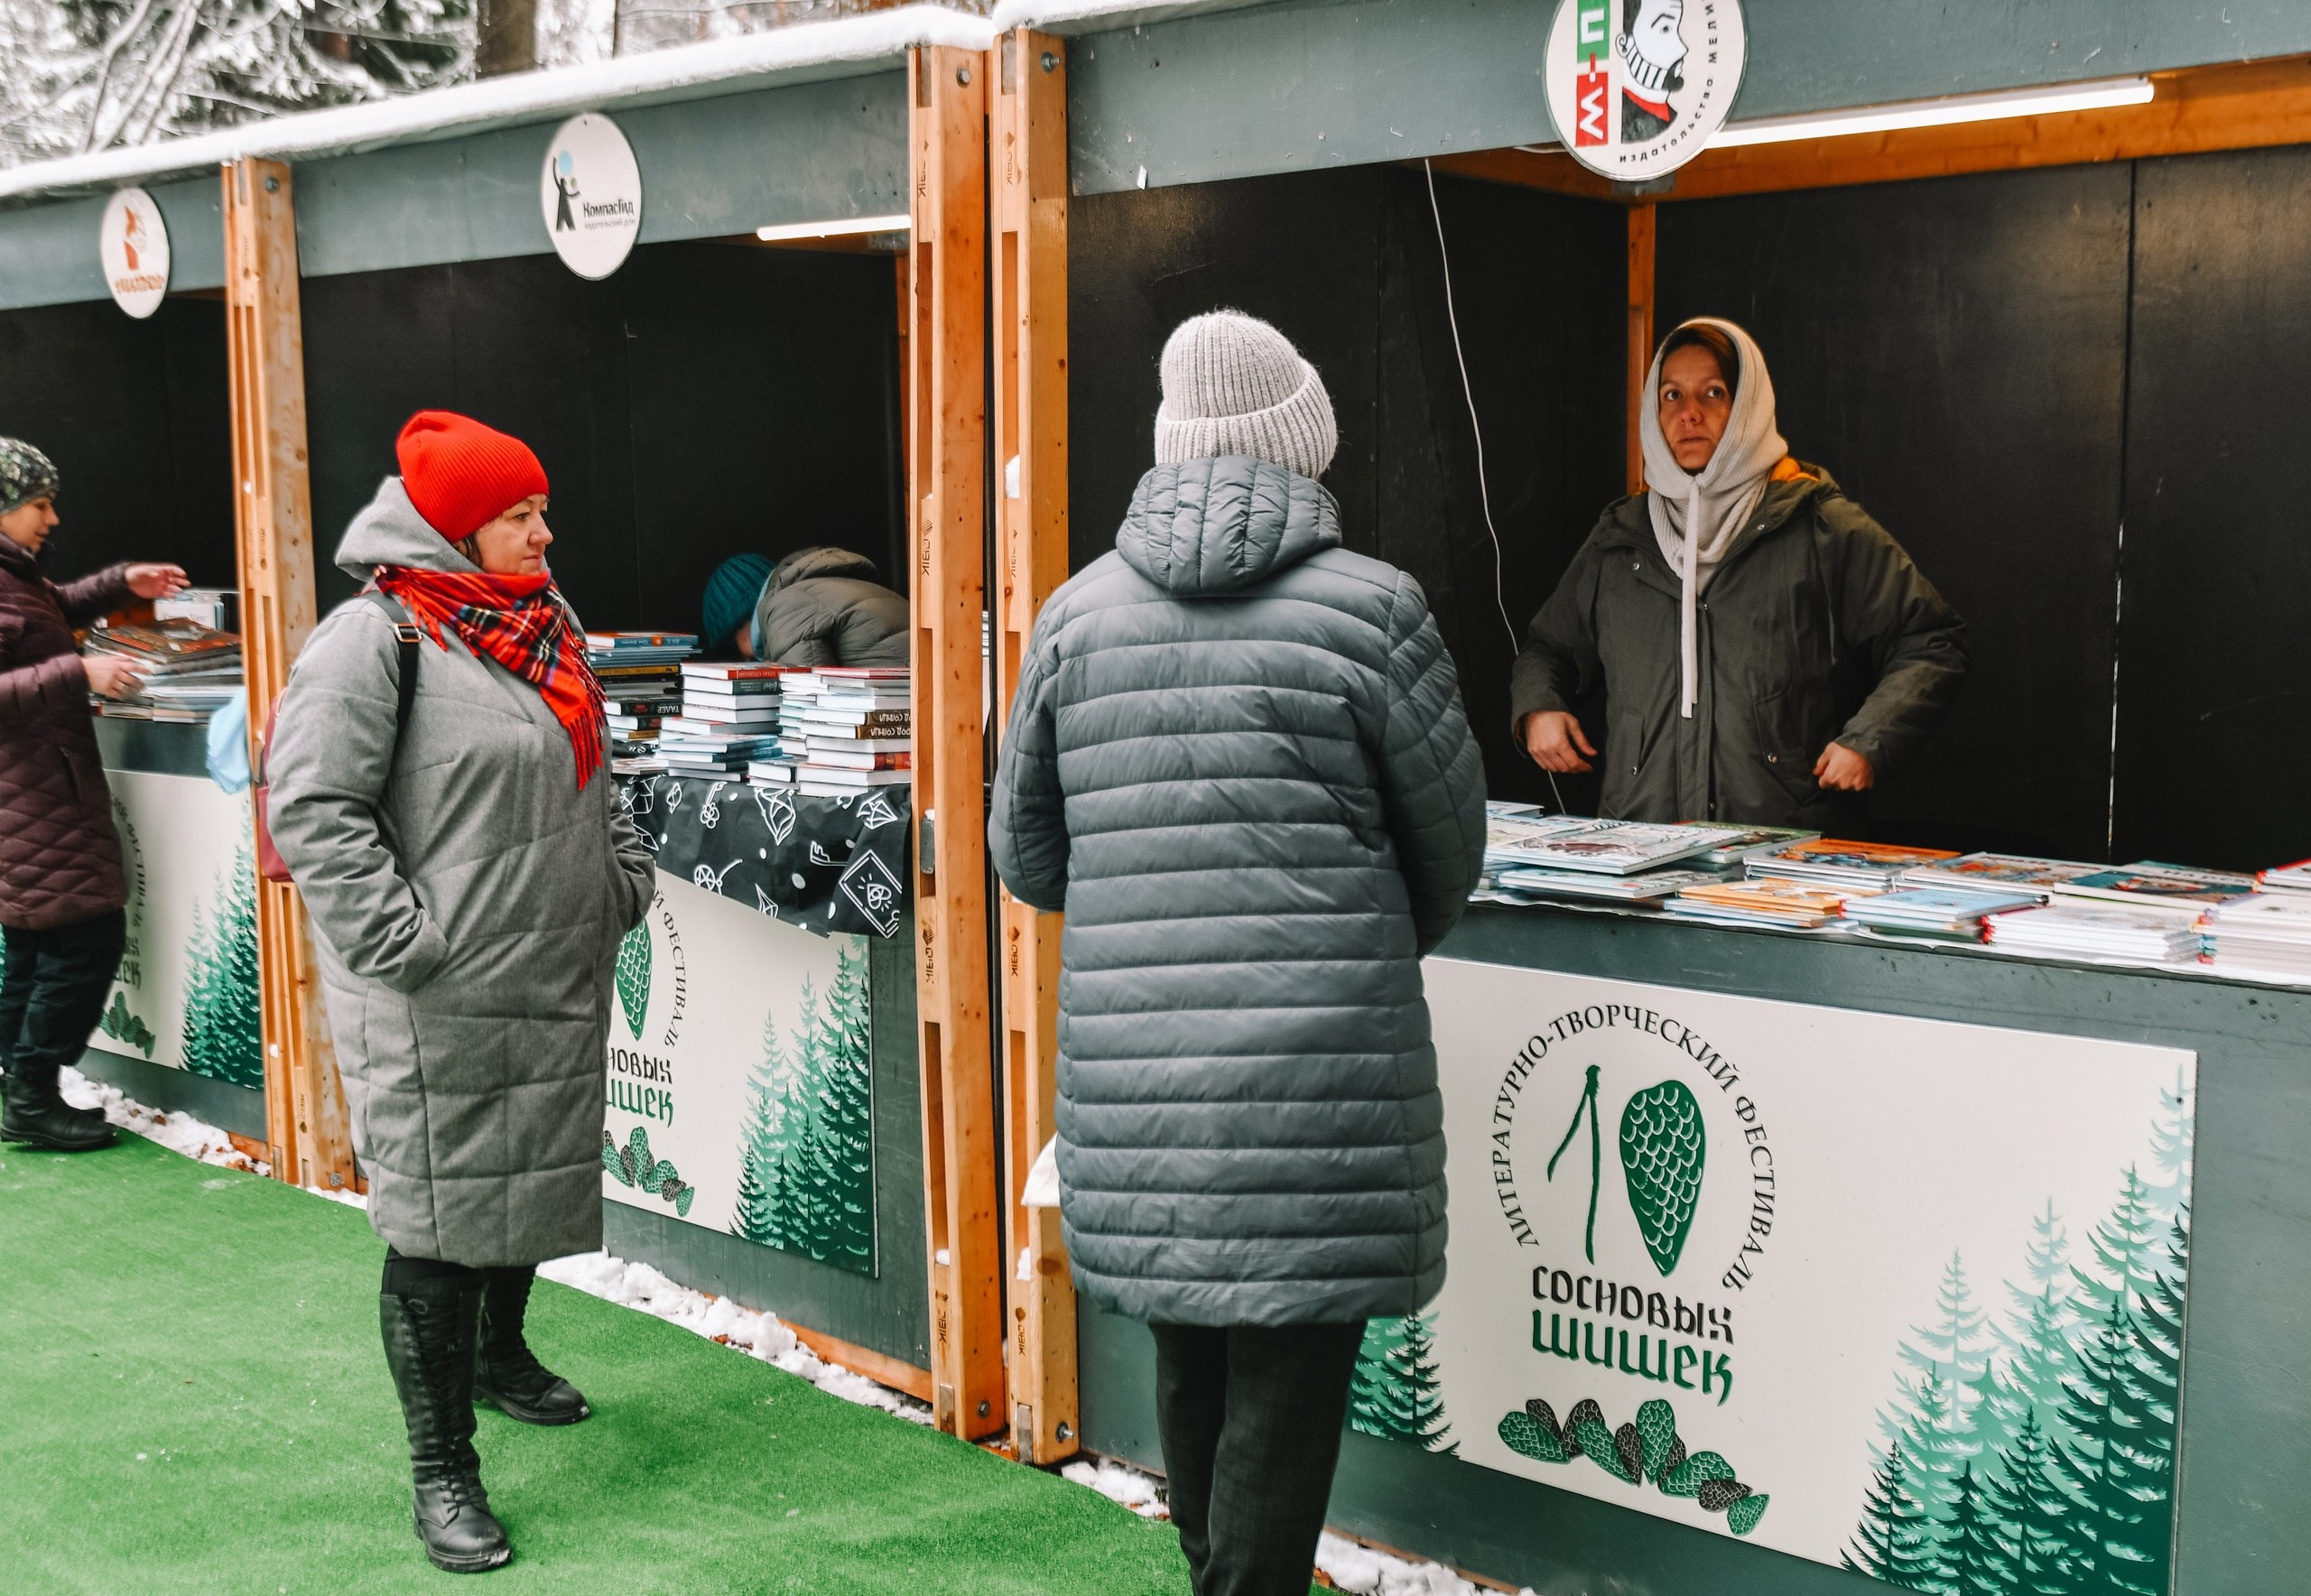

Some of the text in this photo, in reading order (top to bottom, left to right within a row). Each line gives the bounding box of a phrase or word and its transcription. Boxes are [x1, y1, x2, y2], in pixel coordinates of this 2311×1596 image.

[1701, 0, 1719, 64] МЕЛИ
[583, 199, 635, 218] КомпасГид
[664, 912, 687, 1048] ФЕСТИВАЛЬ
[1492, 1005, 1776, 1293] ЛИТЕРАТУРНО-ТВОРЧЕСКИЙ ФЕСТИВАЛЬ
